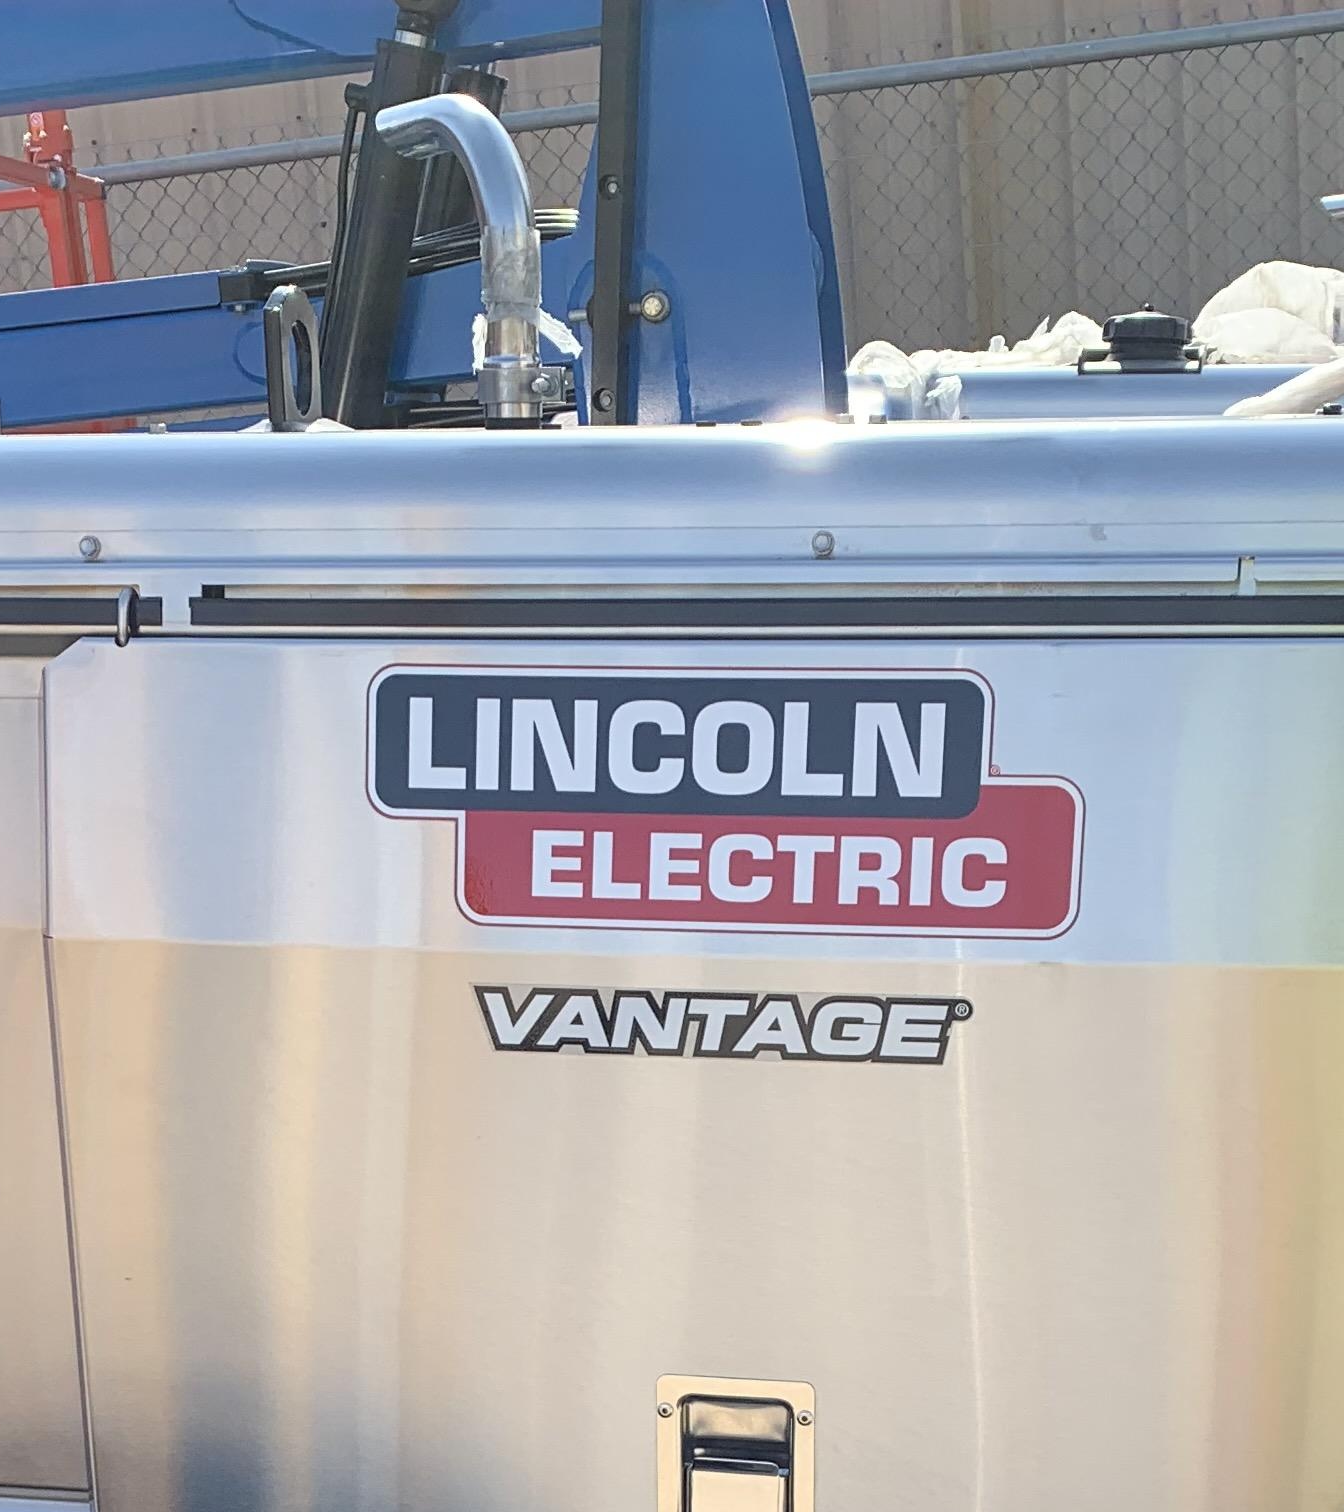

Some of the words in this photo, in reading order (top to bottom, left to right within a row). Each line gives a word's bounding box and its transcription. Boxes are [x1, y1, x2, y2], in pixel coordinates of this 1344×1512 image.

[408, 696, 947, 798] LINCOLN
[531, 829, 1008, 909] ELECTRIC
[476, 986, 953, 1063] VANTAGE
